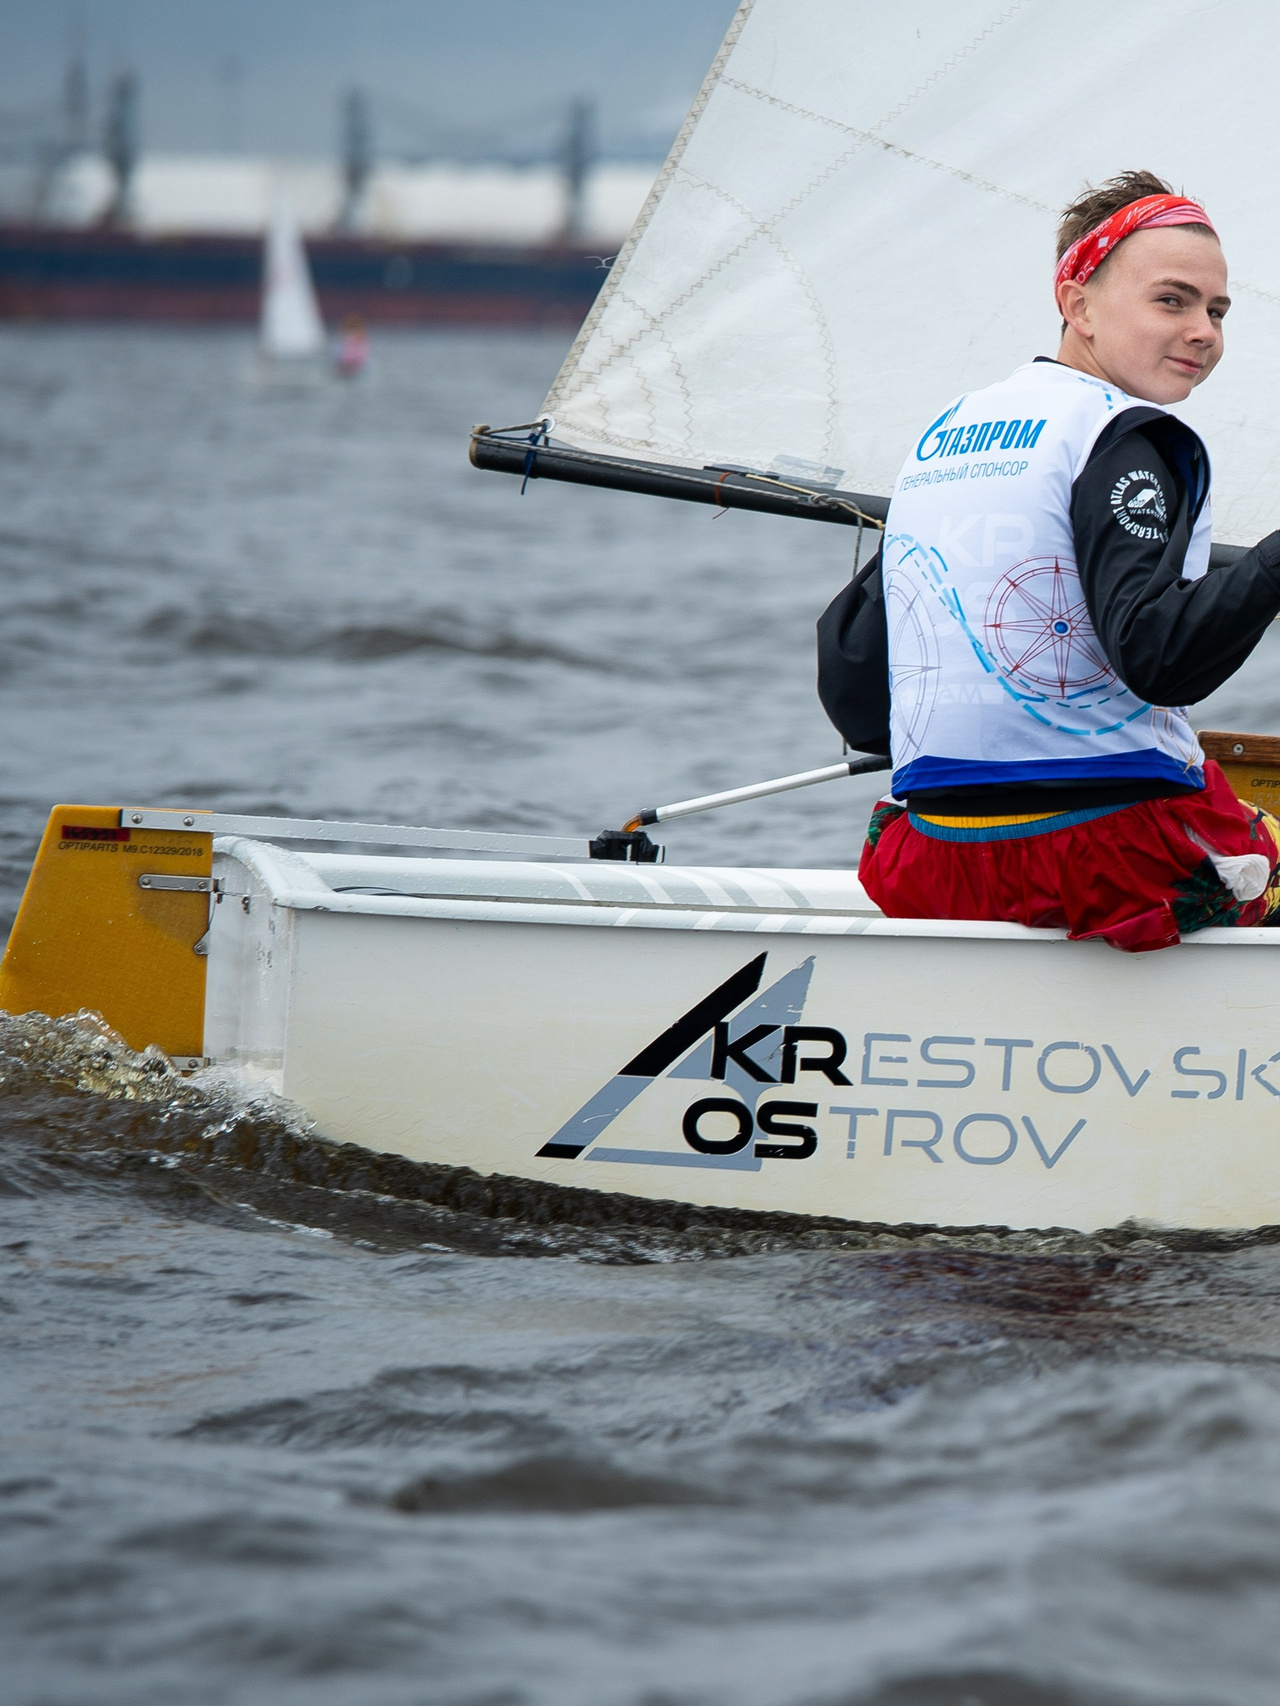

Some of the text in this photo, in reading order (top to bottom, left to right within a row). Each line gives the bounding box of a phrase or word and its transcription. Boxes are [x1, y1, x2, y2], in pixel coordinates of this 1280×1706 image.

[939, 419, 1048, 459] ГАЗПРОМ
[899, 460, 1029, 492] ГЕНЕРАЛЬНЫЙ СПОНСОР
[58, 841, 119, 853] OPTIPARTS
[682, 1097, 1087, 1170] OSTROV
